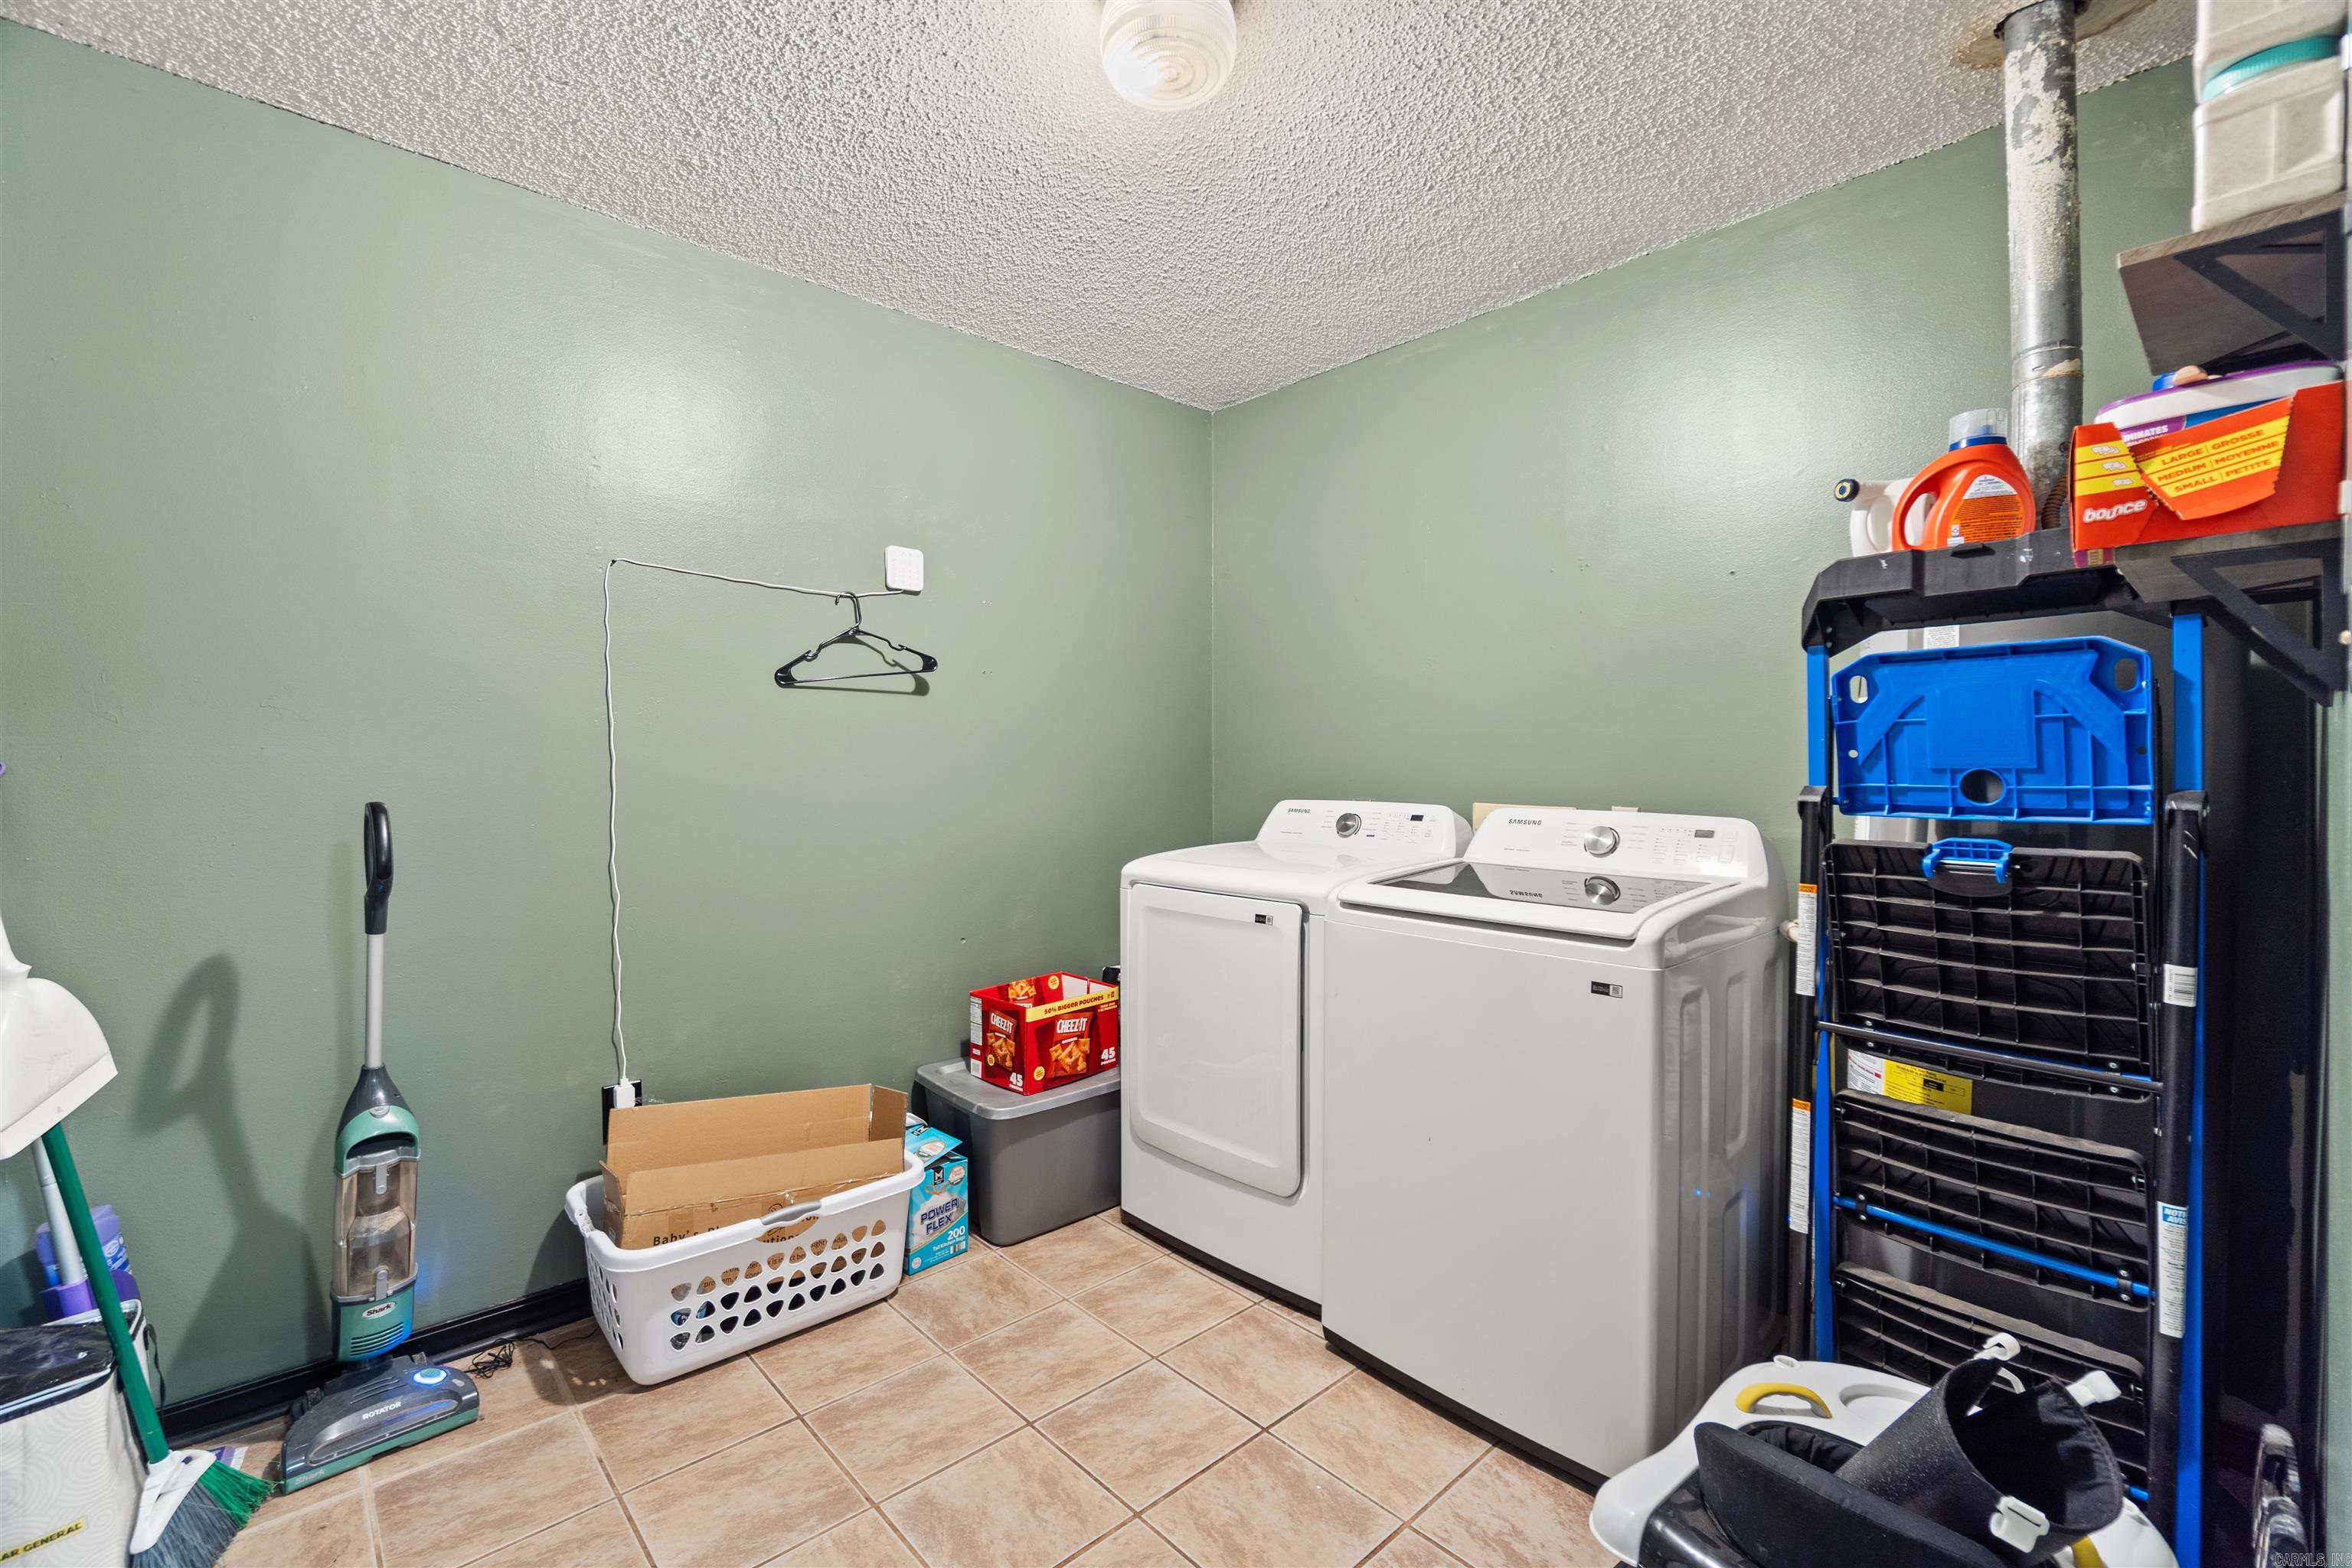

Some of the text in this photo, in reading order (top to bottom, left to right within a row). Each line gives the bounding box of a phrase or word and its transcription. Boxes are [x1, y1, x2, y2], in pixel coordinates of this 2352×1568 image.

[2162, 448, 2203, 465] LARGE
[2212, 430, 2265, 449] GROSSE
[2158, 462, 2207, 482] MEDIUM
[2215, 441, 2279, 464] MOYENNE
[2174, 458, 2272, 492] SMALL PETITE
[2083, 499, 2147, 524] bounce
[1044, 1006, 1057, 1014] 50%
[1101, 1047, 1116, 1060] 45
[1010, 1072, 1023, 1086] 45
[921, 1198, 959, 1224] POWER
[926, 1213, 953, 1234] FLEX
[948, 1226, 965, 1240] 200
[367, 1304, 393, 1316] Shark
[362, 1401, 401, 1419] ROTATOR
[23, 1522, 83, 1551] GENERAL
